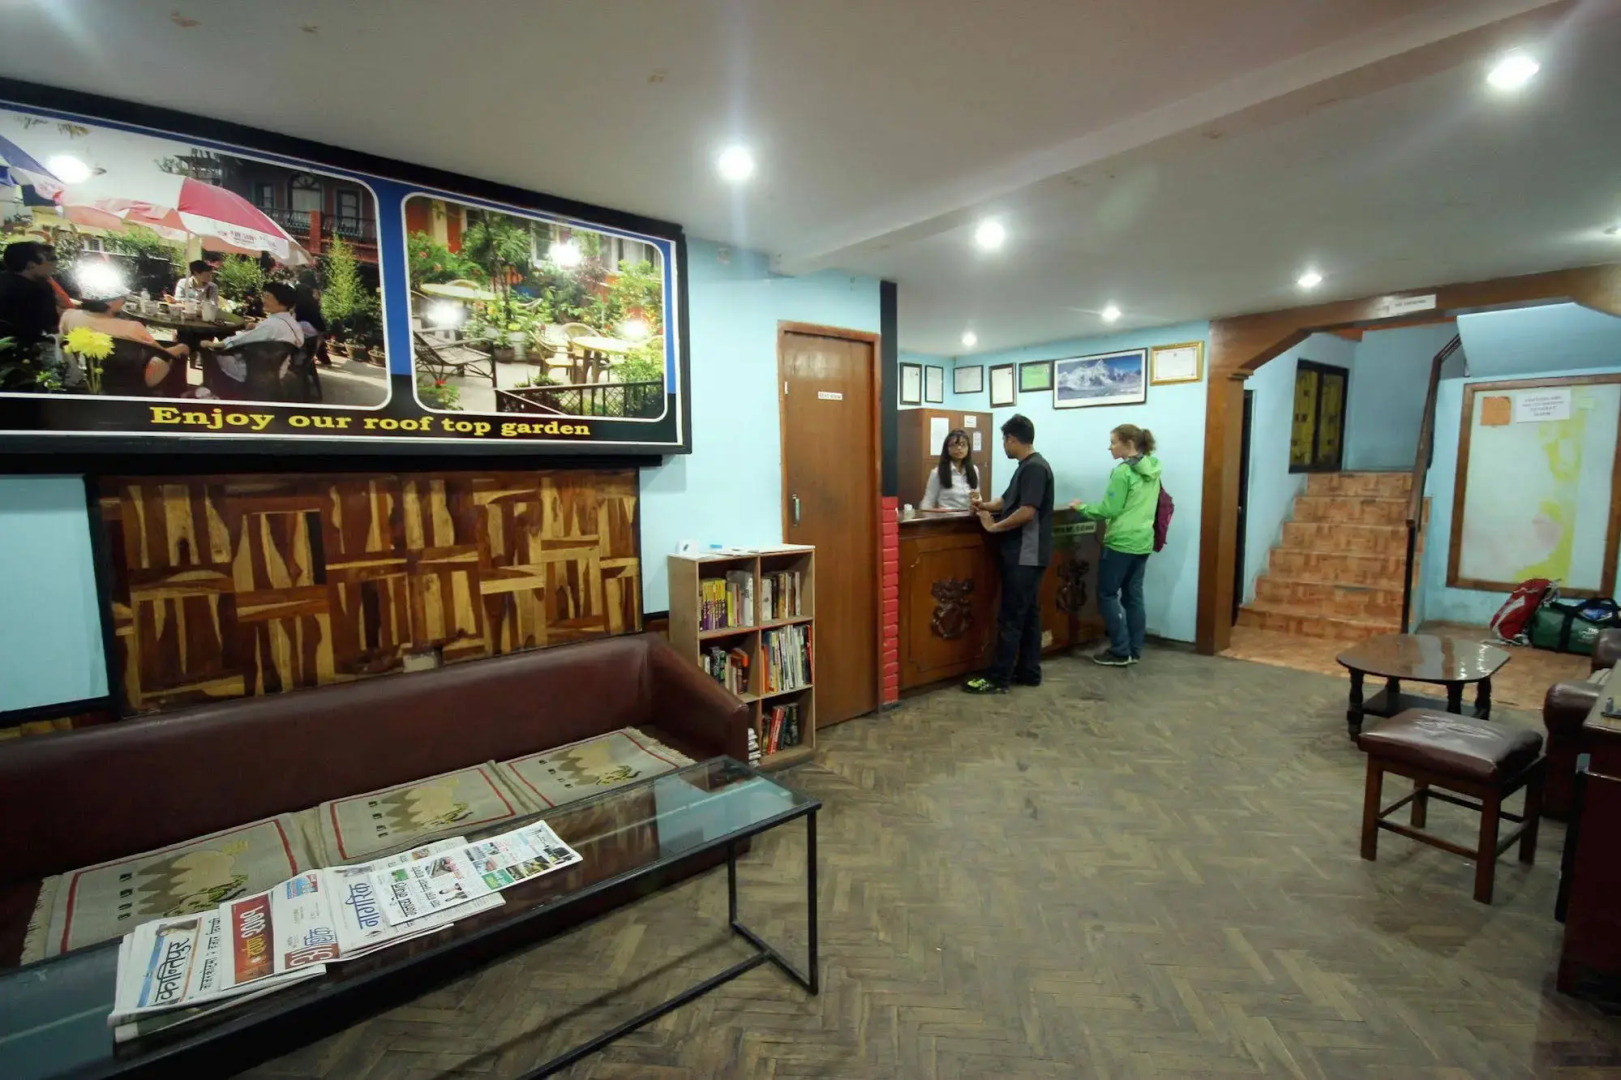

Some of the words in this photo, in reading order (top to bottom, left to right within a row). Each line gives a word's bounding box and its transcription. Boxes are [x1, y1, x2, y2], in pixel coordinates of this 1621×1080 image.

[149, 406, 274, 430] Enjoy
[288, 414, 352, 429] our
[363, 416, 434, 431] roof
[441, 418, 491, 437] top
[501, 421, 591, 437] garden
[344, 882, 381, 930] नागरिक
[155, 938, 192, 1003] कान्तिपुर
